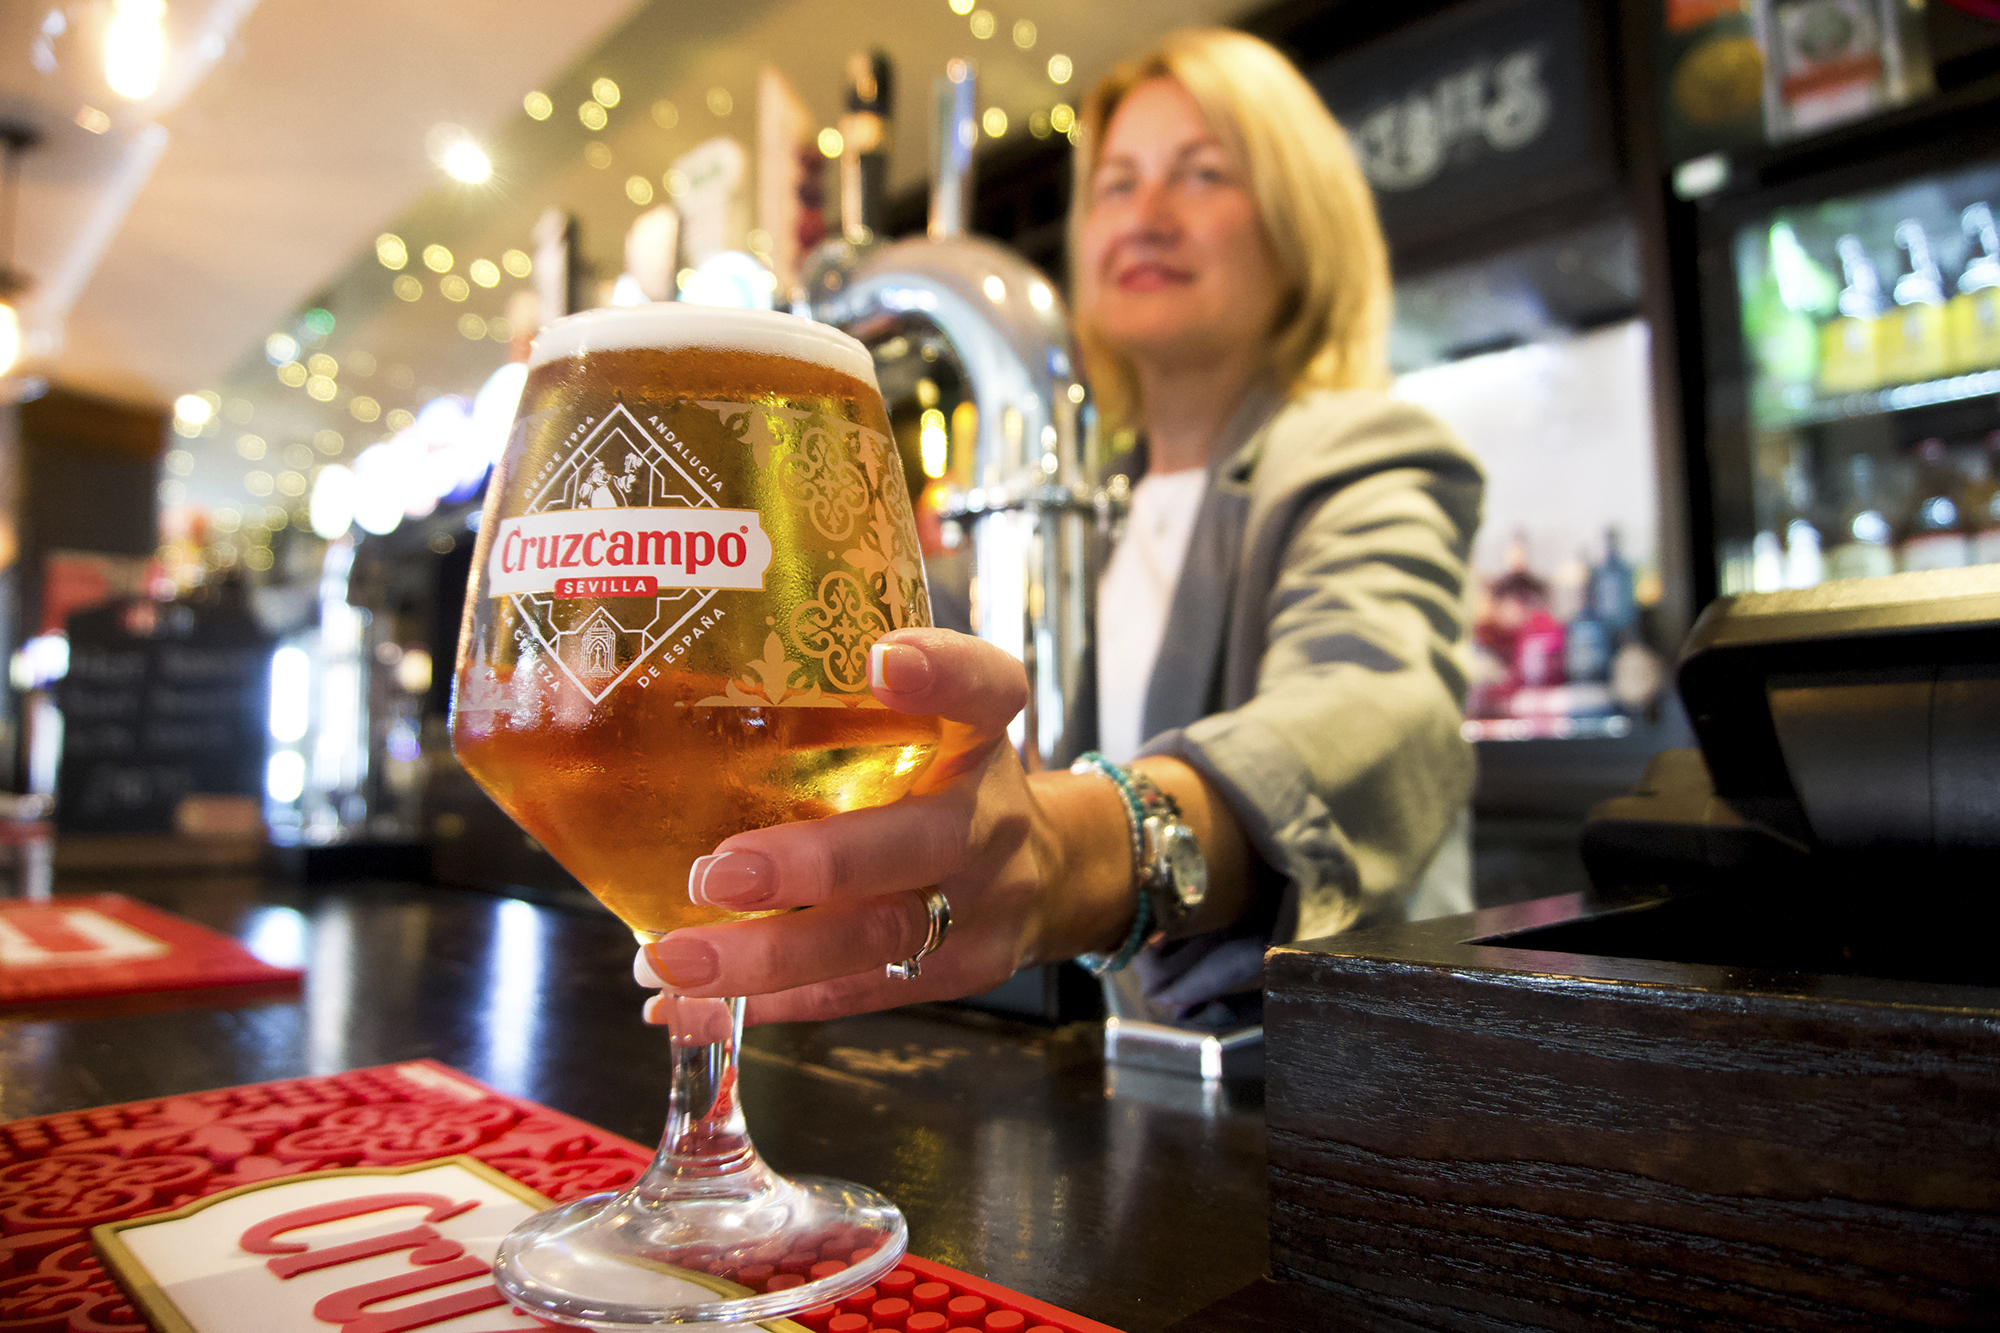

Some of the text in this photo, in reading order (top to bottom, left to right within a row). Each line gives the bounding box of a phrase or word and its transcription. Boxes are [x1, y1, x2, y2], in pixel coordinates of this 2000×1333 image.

[523, 416, 594, 499] DESDE 1904
[647, 415, 723, 492] ANDALUCÍA
[501, 525, 747, 575] Cruzcampo
[563, 580, 647, 595] SEVILLA
[637, 608, 726, 689] DE ESPAÑA
[240, 1192, 560, 1333] Cru
